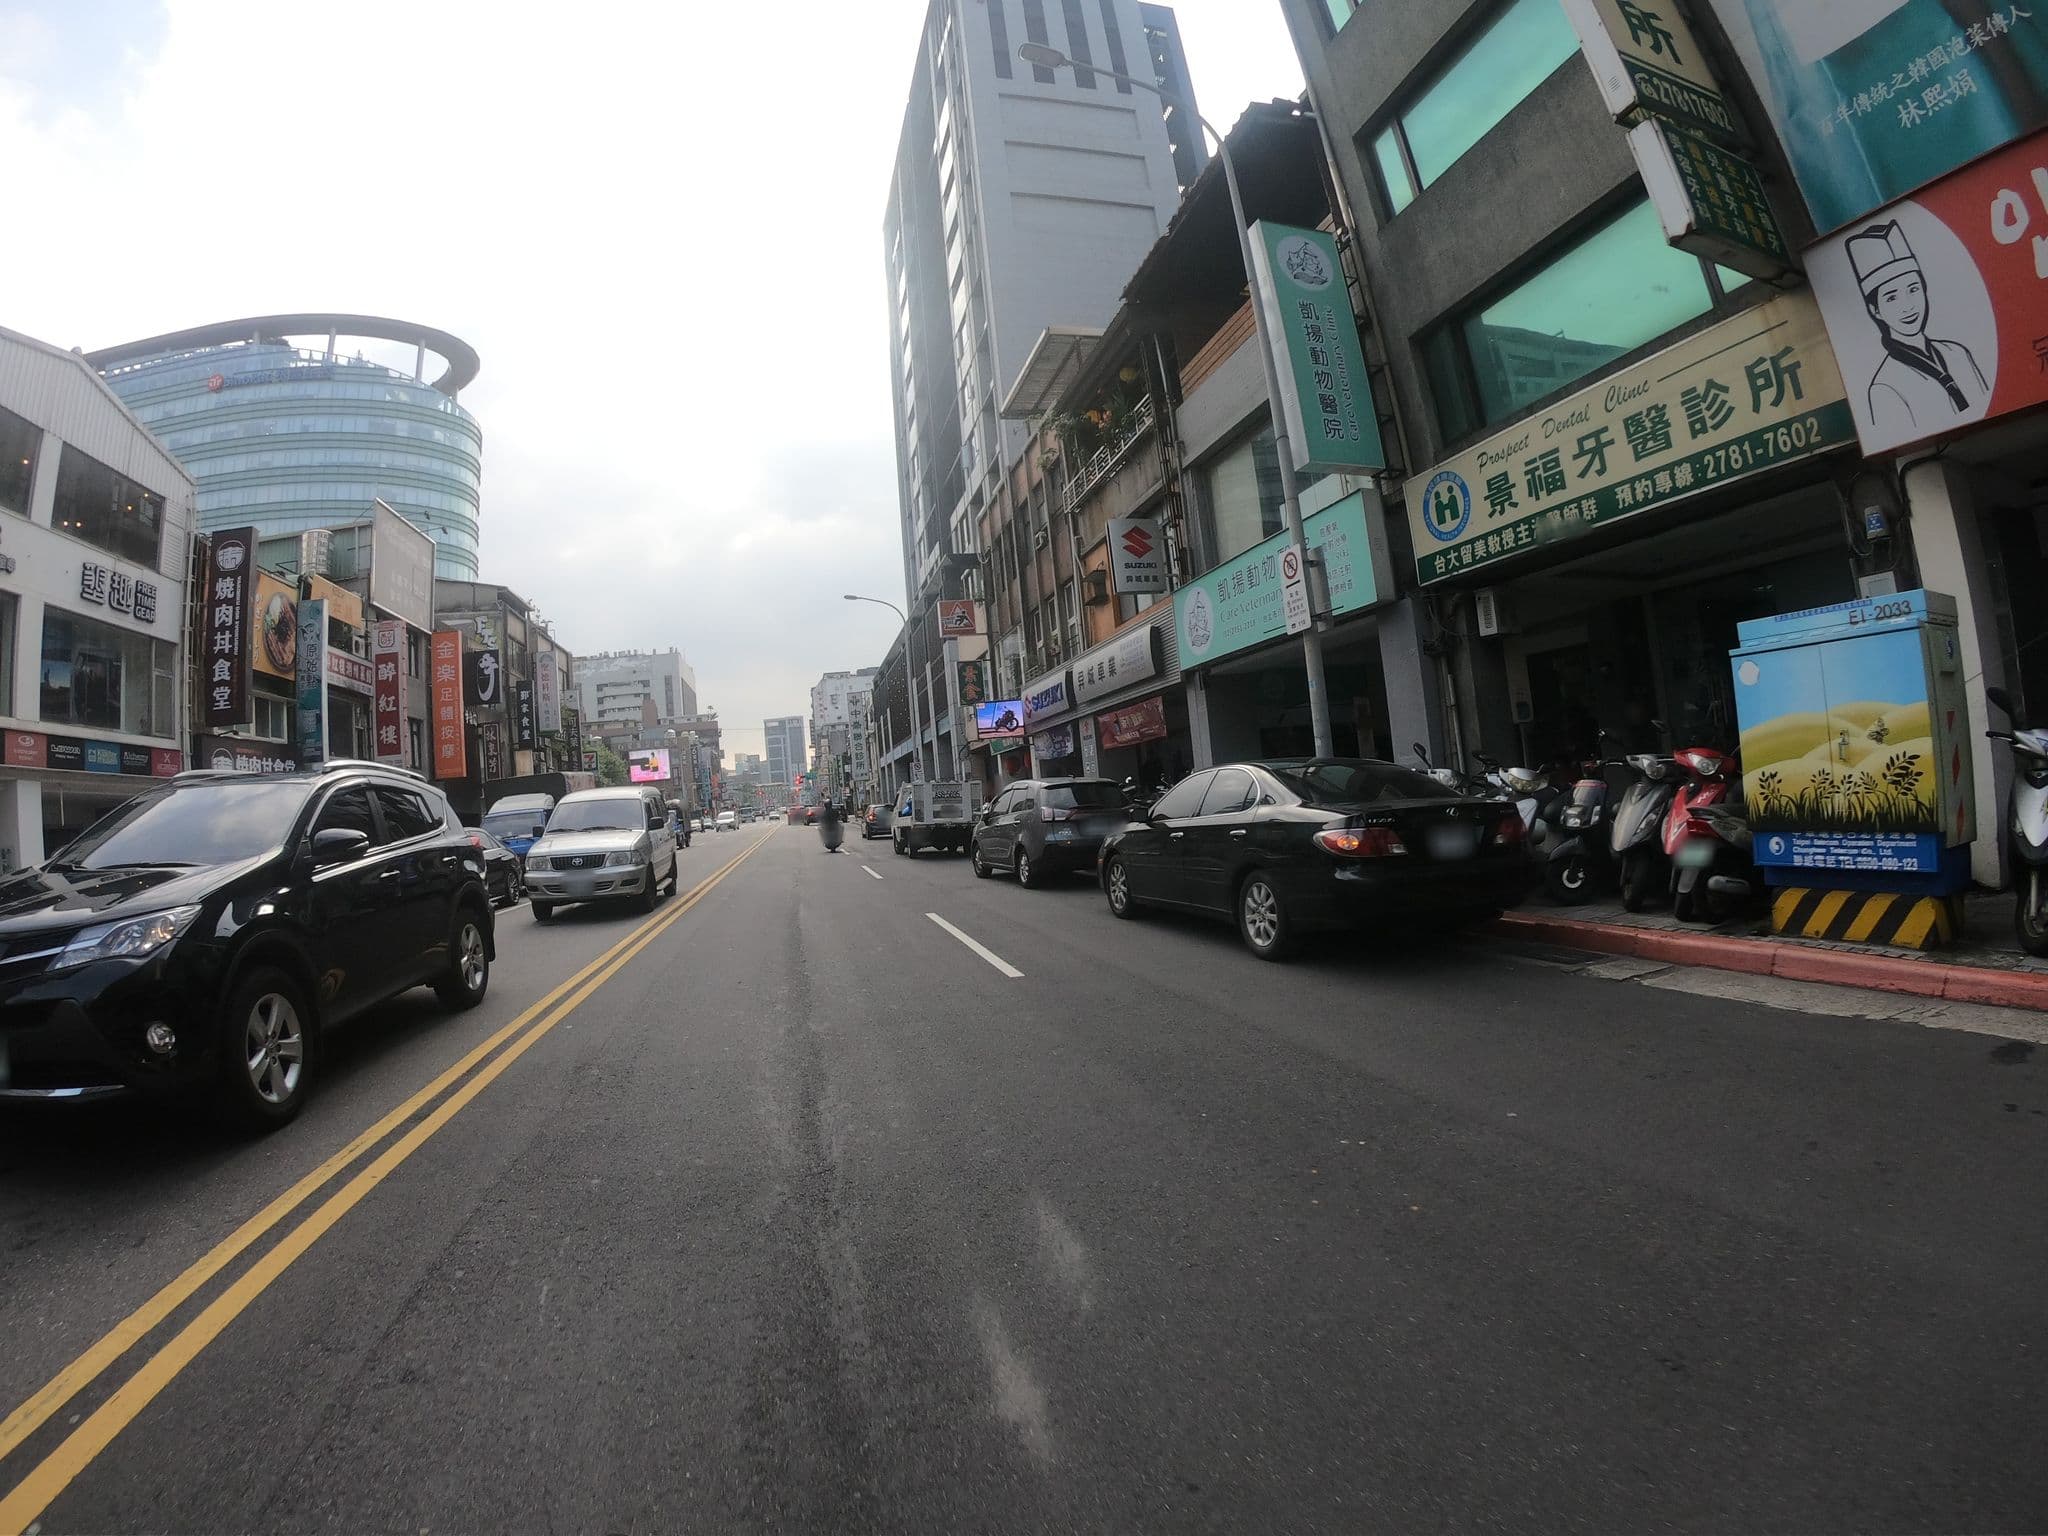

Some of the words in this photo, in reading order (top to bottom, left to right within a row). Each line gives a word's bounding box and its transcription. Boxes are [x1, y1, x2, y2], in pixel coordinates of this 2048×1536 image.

[1617, 0, 1683, 65] 所
[1898, 68, 1977, 129] 林熙娟
[1299, 300, 1345, 441] 凱揚動物醫院
[1477, 433, 1530, 474] Prospect
[1542, 402, 1591, 437] Dental
[1604, 378, 1651, 414] Clinic
[1483, 344, 1805, 519] 景福牙醫診所
[135, 605, 156, 622] GEAR
[136, 593, 156, 609] TIME
[137, 582, 157, 597] FREE
[378, 661, 398, 745] 醉紅樓
[1032, 682, 1064, 712] SUZUKI
